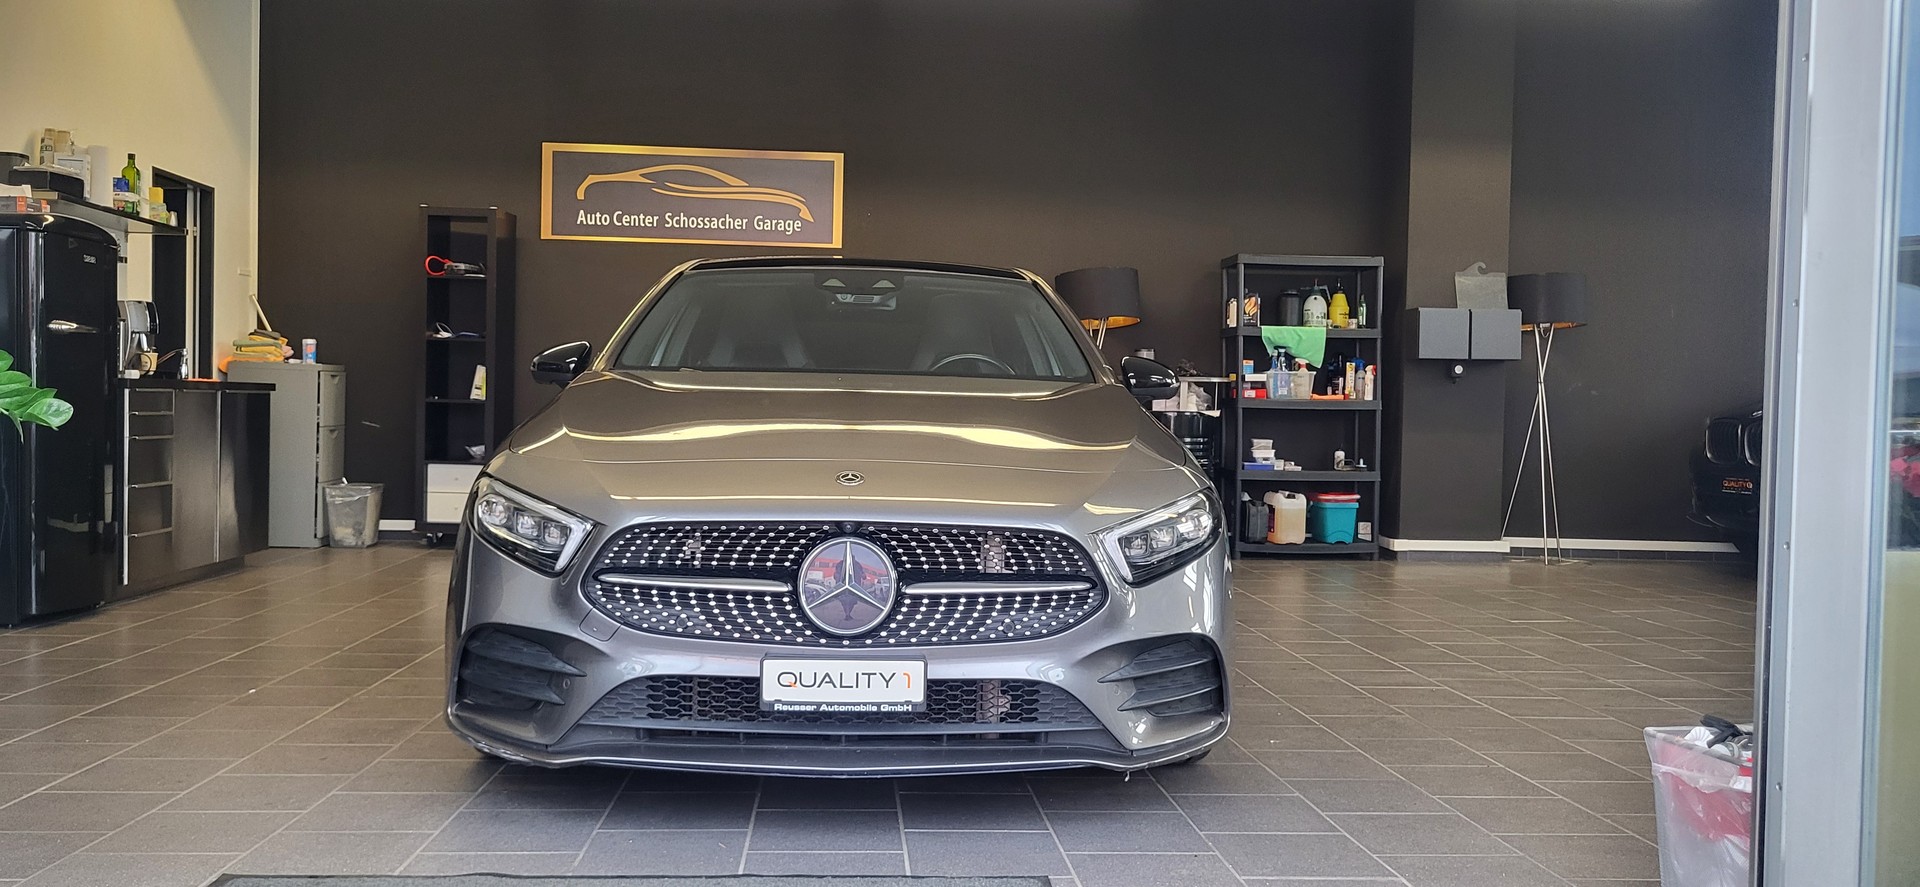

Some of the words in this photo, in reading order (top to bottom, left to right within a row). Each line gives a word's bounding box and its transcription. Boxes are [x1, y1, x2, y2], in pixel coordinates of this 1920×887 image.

[576, 209, 610, 226] Auto
[613, 210, 659, 228] Center
[664, 212, 748, 230] Schossacher
[753, 215, 802, 235] Garage
[777, 671, 896, 689] QUALITY
[902, 672, 911, 689] 1
[774, 703, 817, 712] Reusser
[819, 703, 878, 712] Automobile
[880, 703, 912, 712] GmbH
